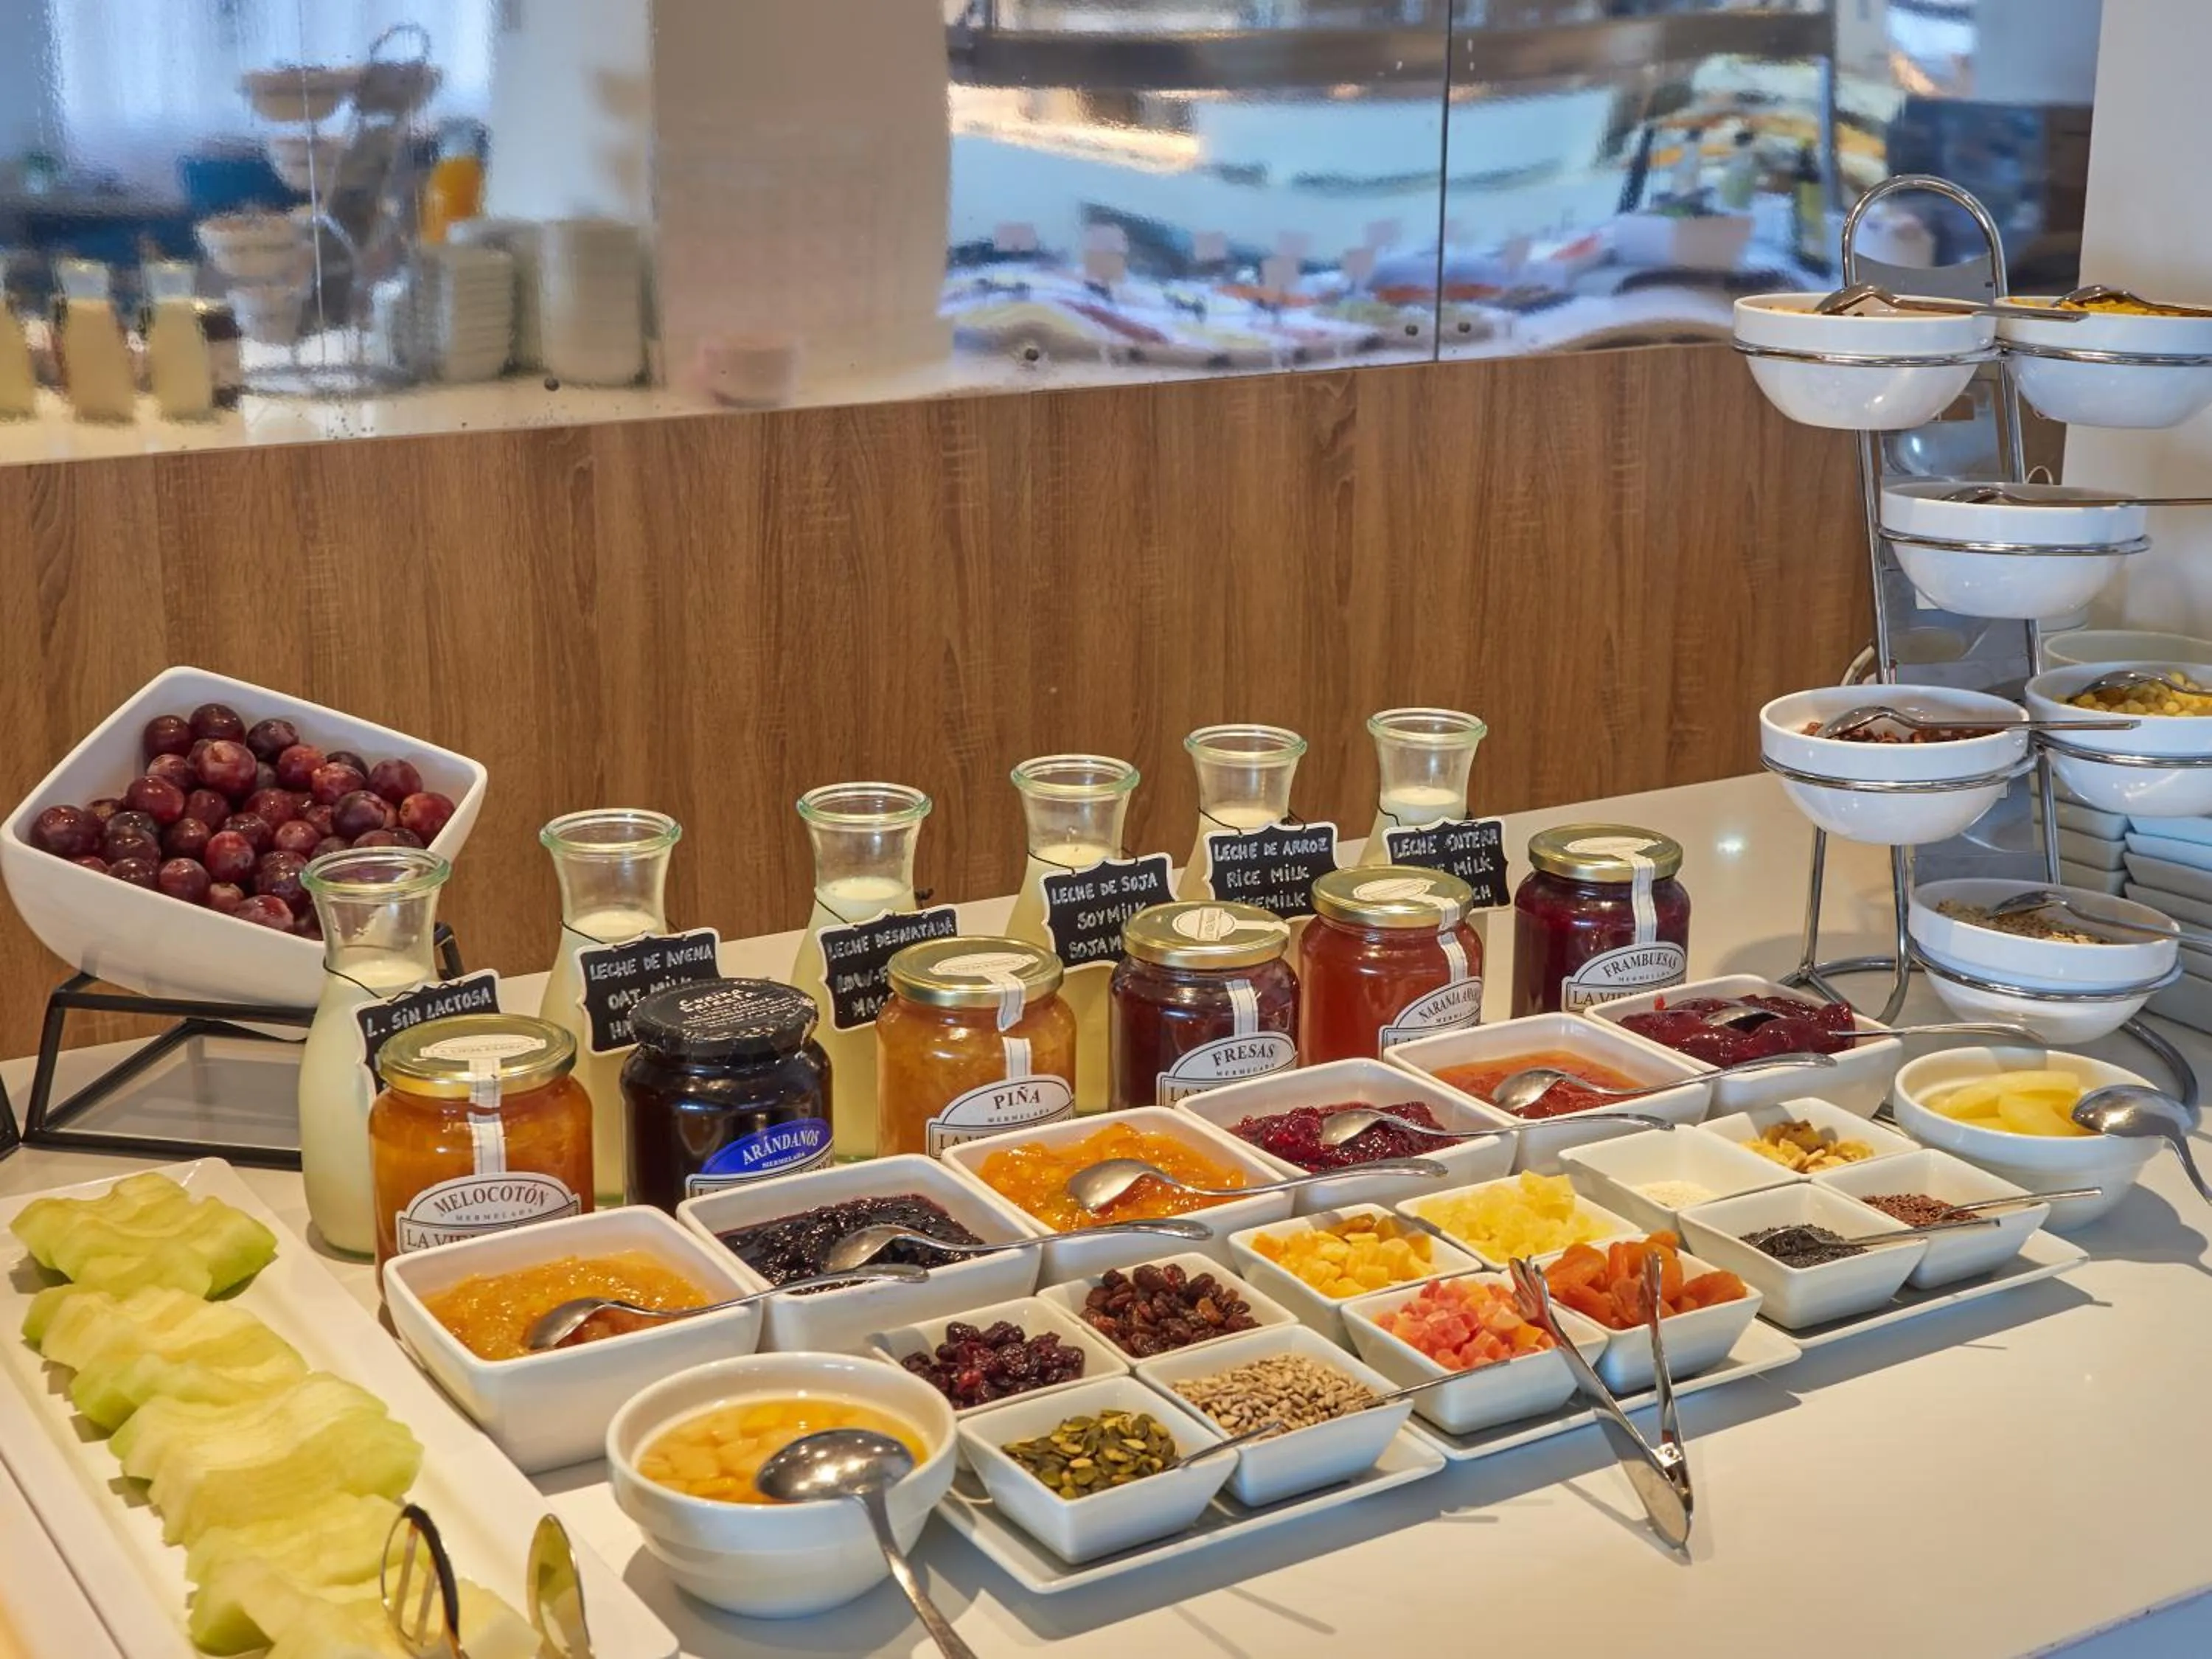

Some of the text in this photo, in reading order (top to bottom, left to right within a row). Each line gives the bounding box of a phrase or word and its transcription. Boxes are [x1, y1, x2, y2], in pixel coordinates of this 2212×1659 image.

[1214, 841, 1258, 862] LECHE
[1263, 841, 1278, 856] DE
[1393, 835, 1437, 859] LECHE
[1051, 872, 1158, 905] LECHE DE SOJA
[827, 935, 869, 961] LECHE
[590, 944, 714, 981] LECHE DE AVENA
[427, 987, 492, 1019] LACTOSA
[608, 987, 641, 1010] OAT
[1211, 1043, 1275, 1067] FRESAS
[993, 1087, 1040, 1110] PIÑA
[742, 1130, 820, 1166] ARÁNDANOS
[433, 1183, 549, 1217] MELOCOTÓN
[407, 1229, 429, 1248] LA
